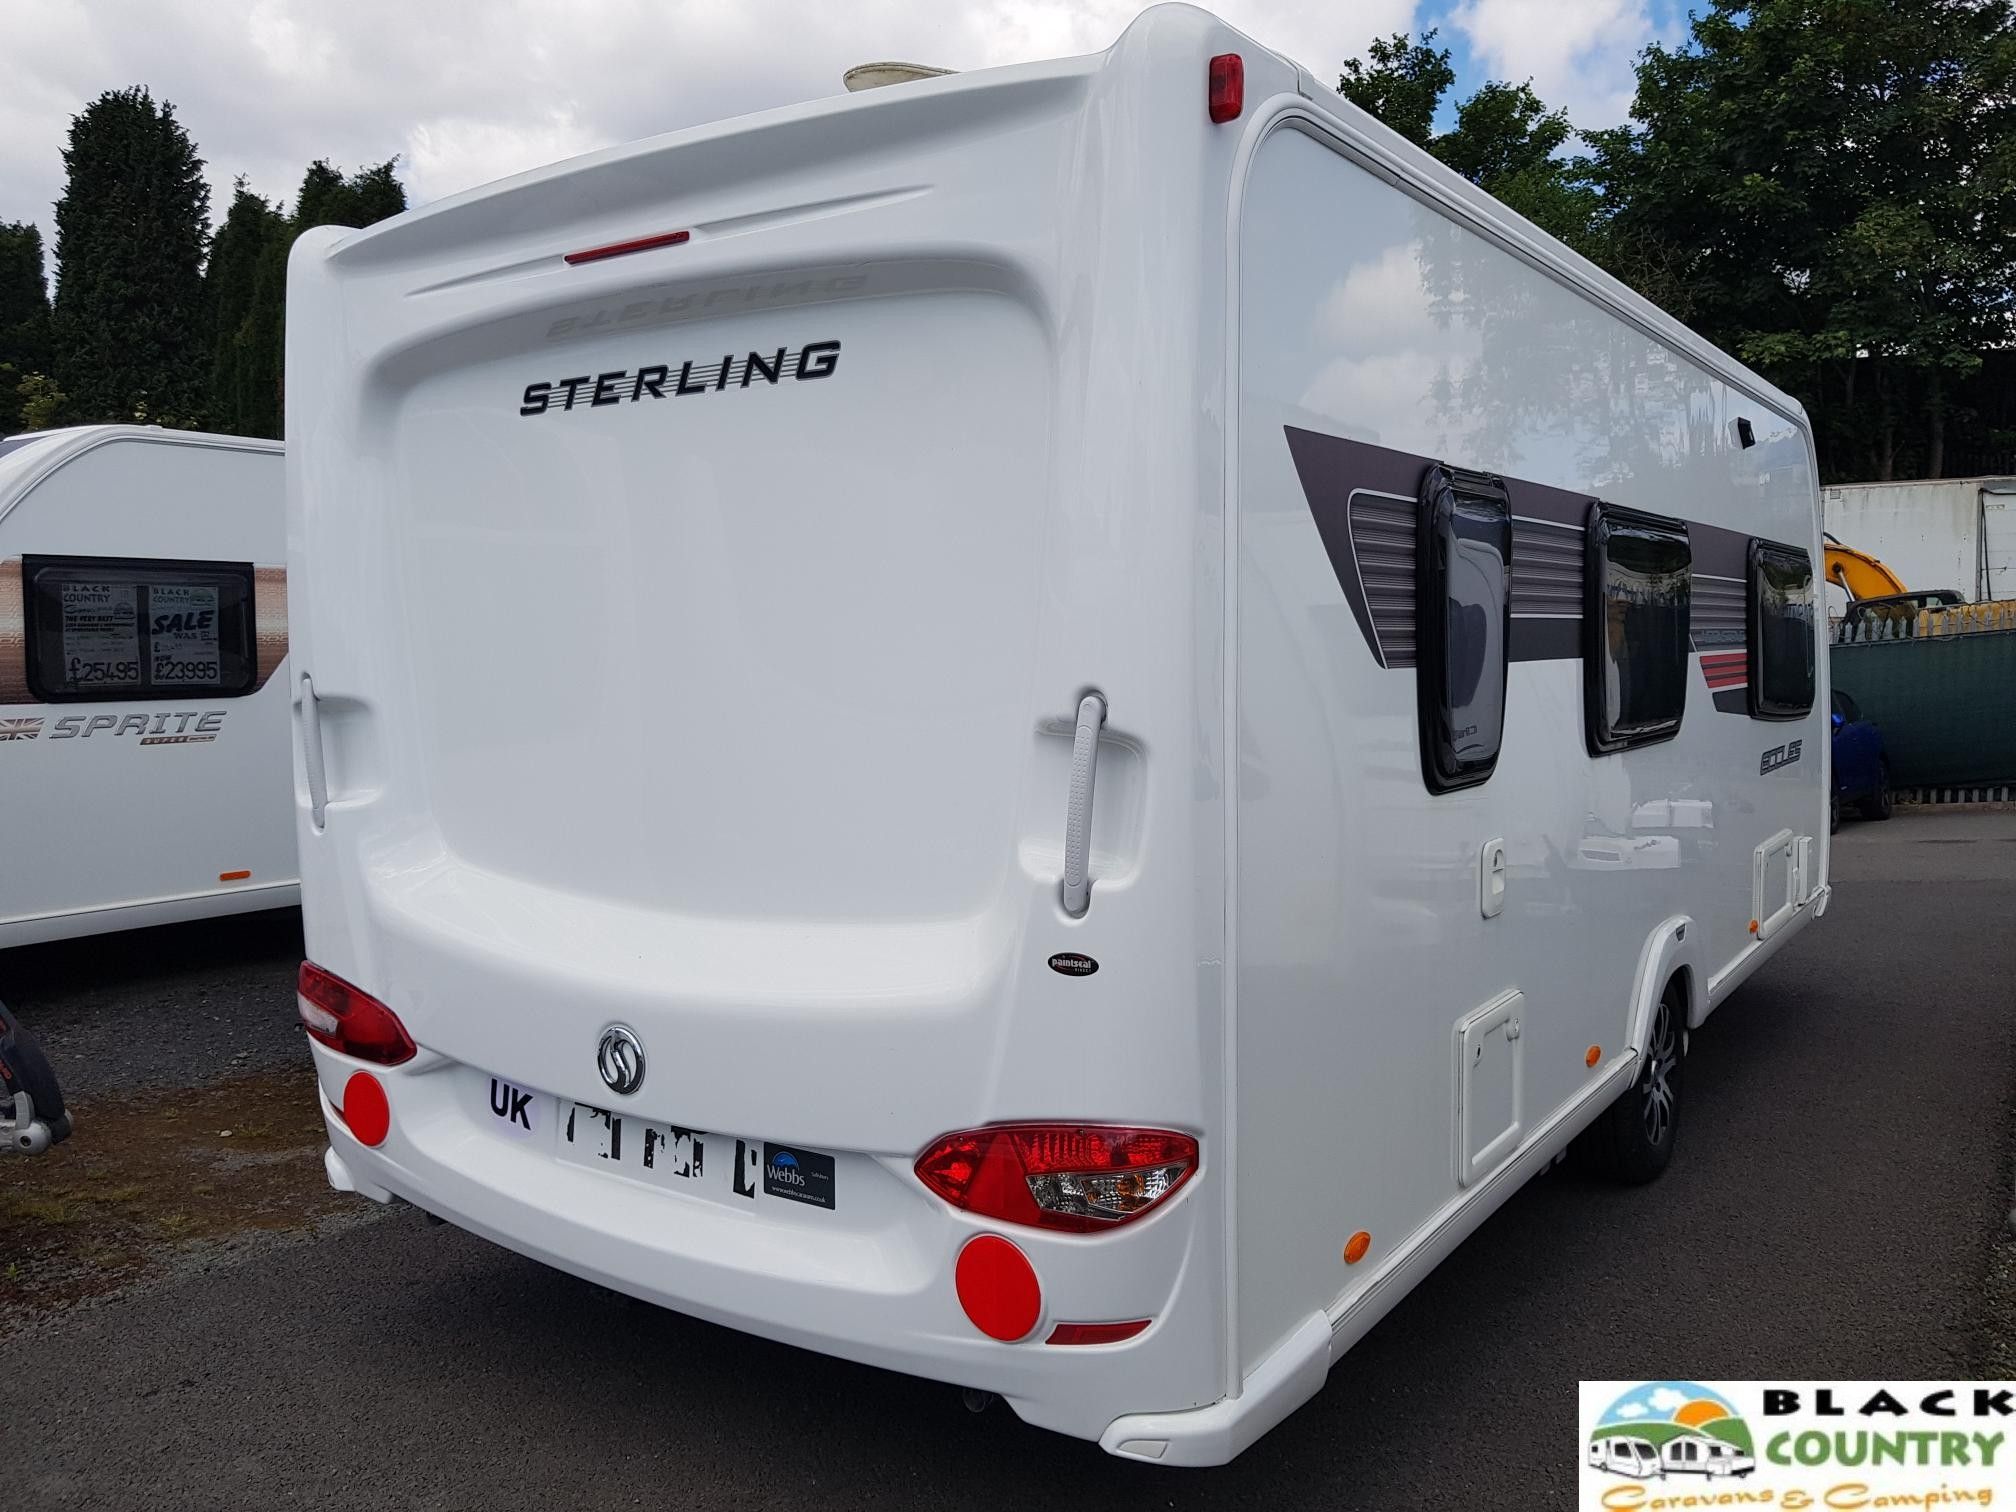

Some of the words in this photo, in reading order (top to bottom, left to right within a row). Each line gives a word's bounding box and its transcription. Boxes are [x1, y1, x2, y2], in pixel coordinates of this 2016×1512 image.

[520, 340, 841, 417] STERLING
[63, 584, 110, 592] BLACK
[64, 593, 110, 602] COUNTRY
[153, 588, 190, 596] BLACK
[152, 610, 214, 635] SALE
[174, 632, 197, 640] WAS
[49, 711, 227, 739] SPRITE
[1760, 739, 1803, 776] ECCLES
[490, 1077, 533, 1130] UK
[767, 1164, 806, 1186] Webbs
